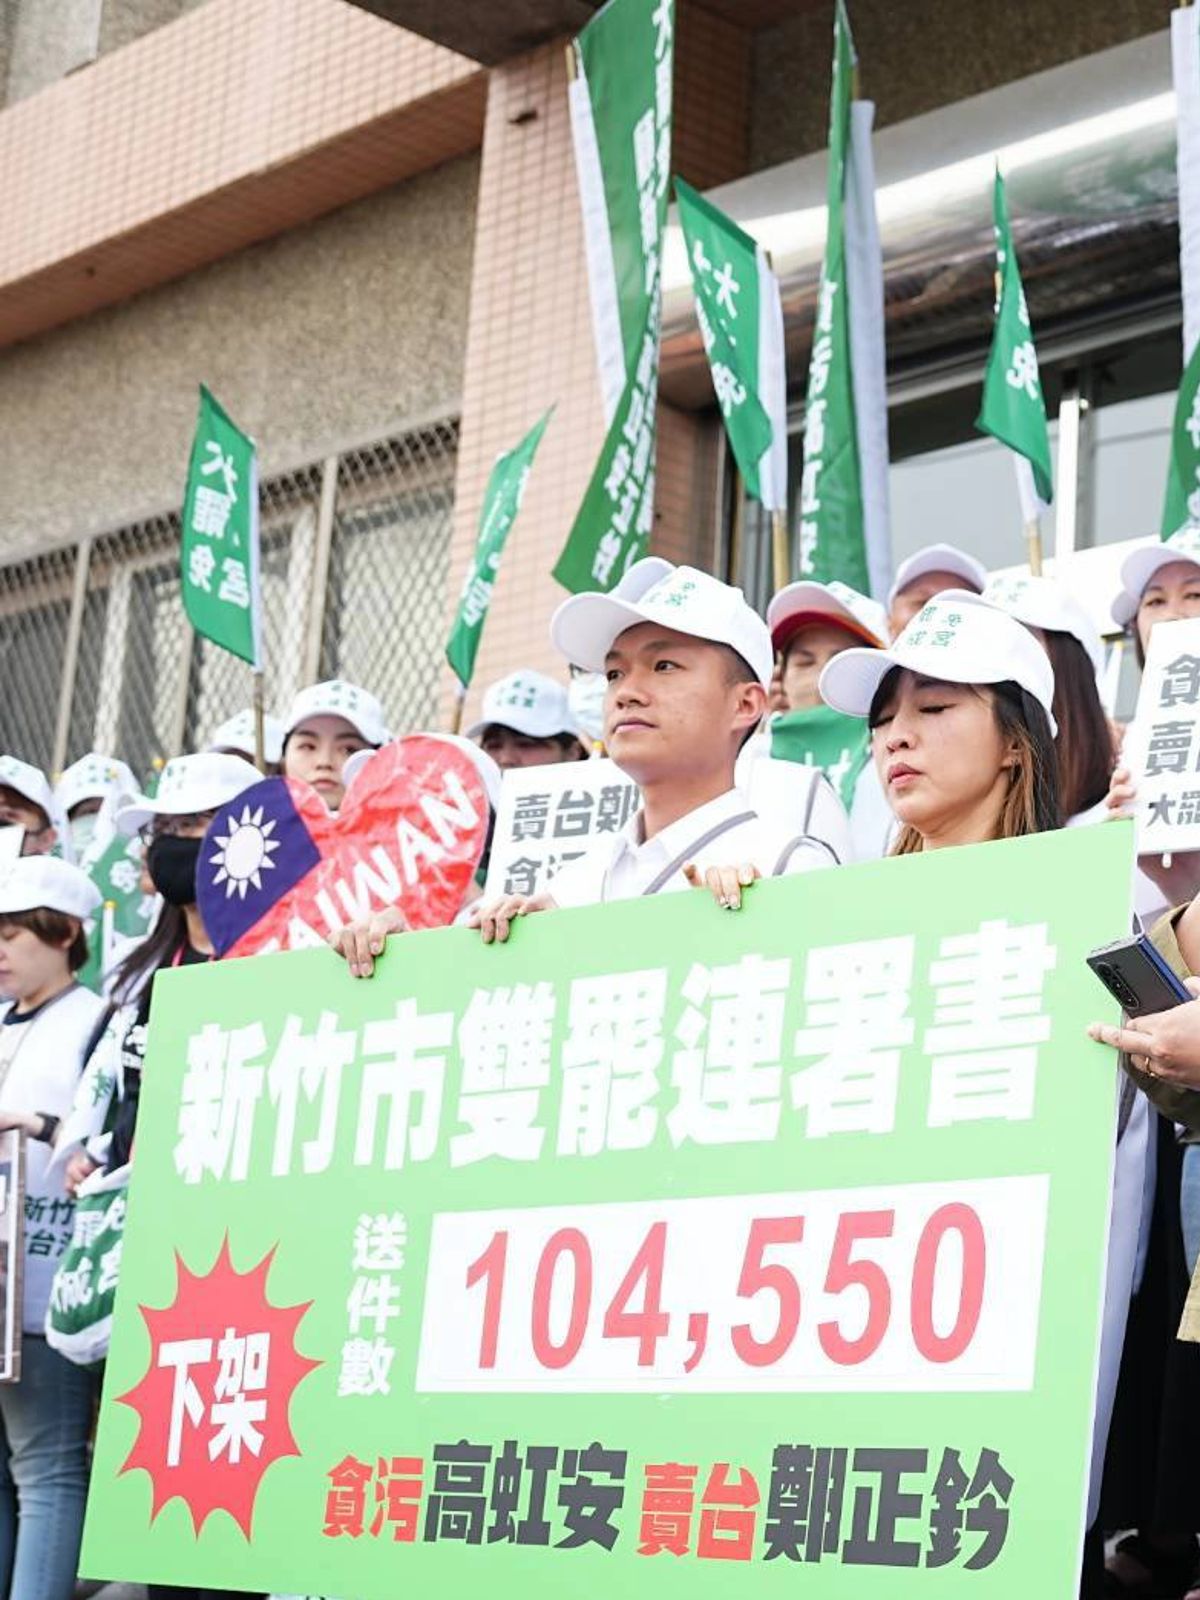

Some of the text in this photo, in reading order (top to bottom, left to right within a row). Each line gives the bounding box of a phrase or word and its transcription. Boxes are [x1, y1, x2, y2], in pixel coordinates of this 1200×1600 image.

[173, 917, 1058, 1185] 新竹市雙罷連署書
[336, 1212, 409, 1398] 送件數
[464, 1200, 988, 1374] 104,550
[156, 1327, 271, 1468] 下架
[321, 1439, 1015, 1572] 貪污高虹安 賣台鄭正鈐
